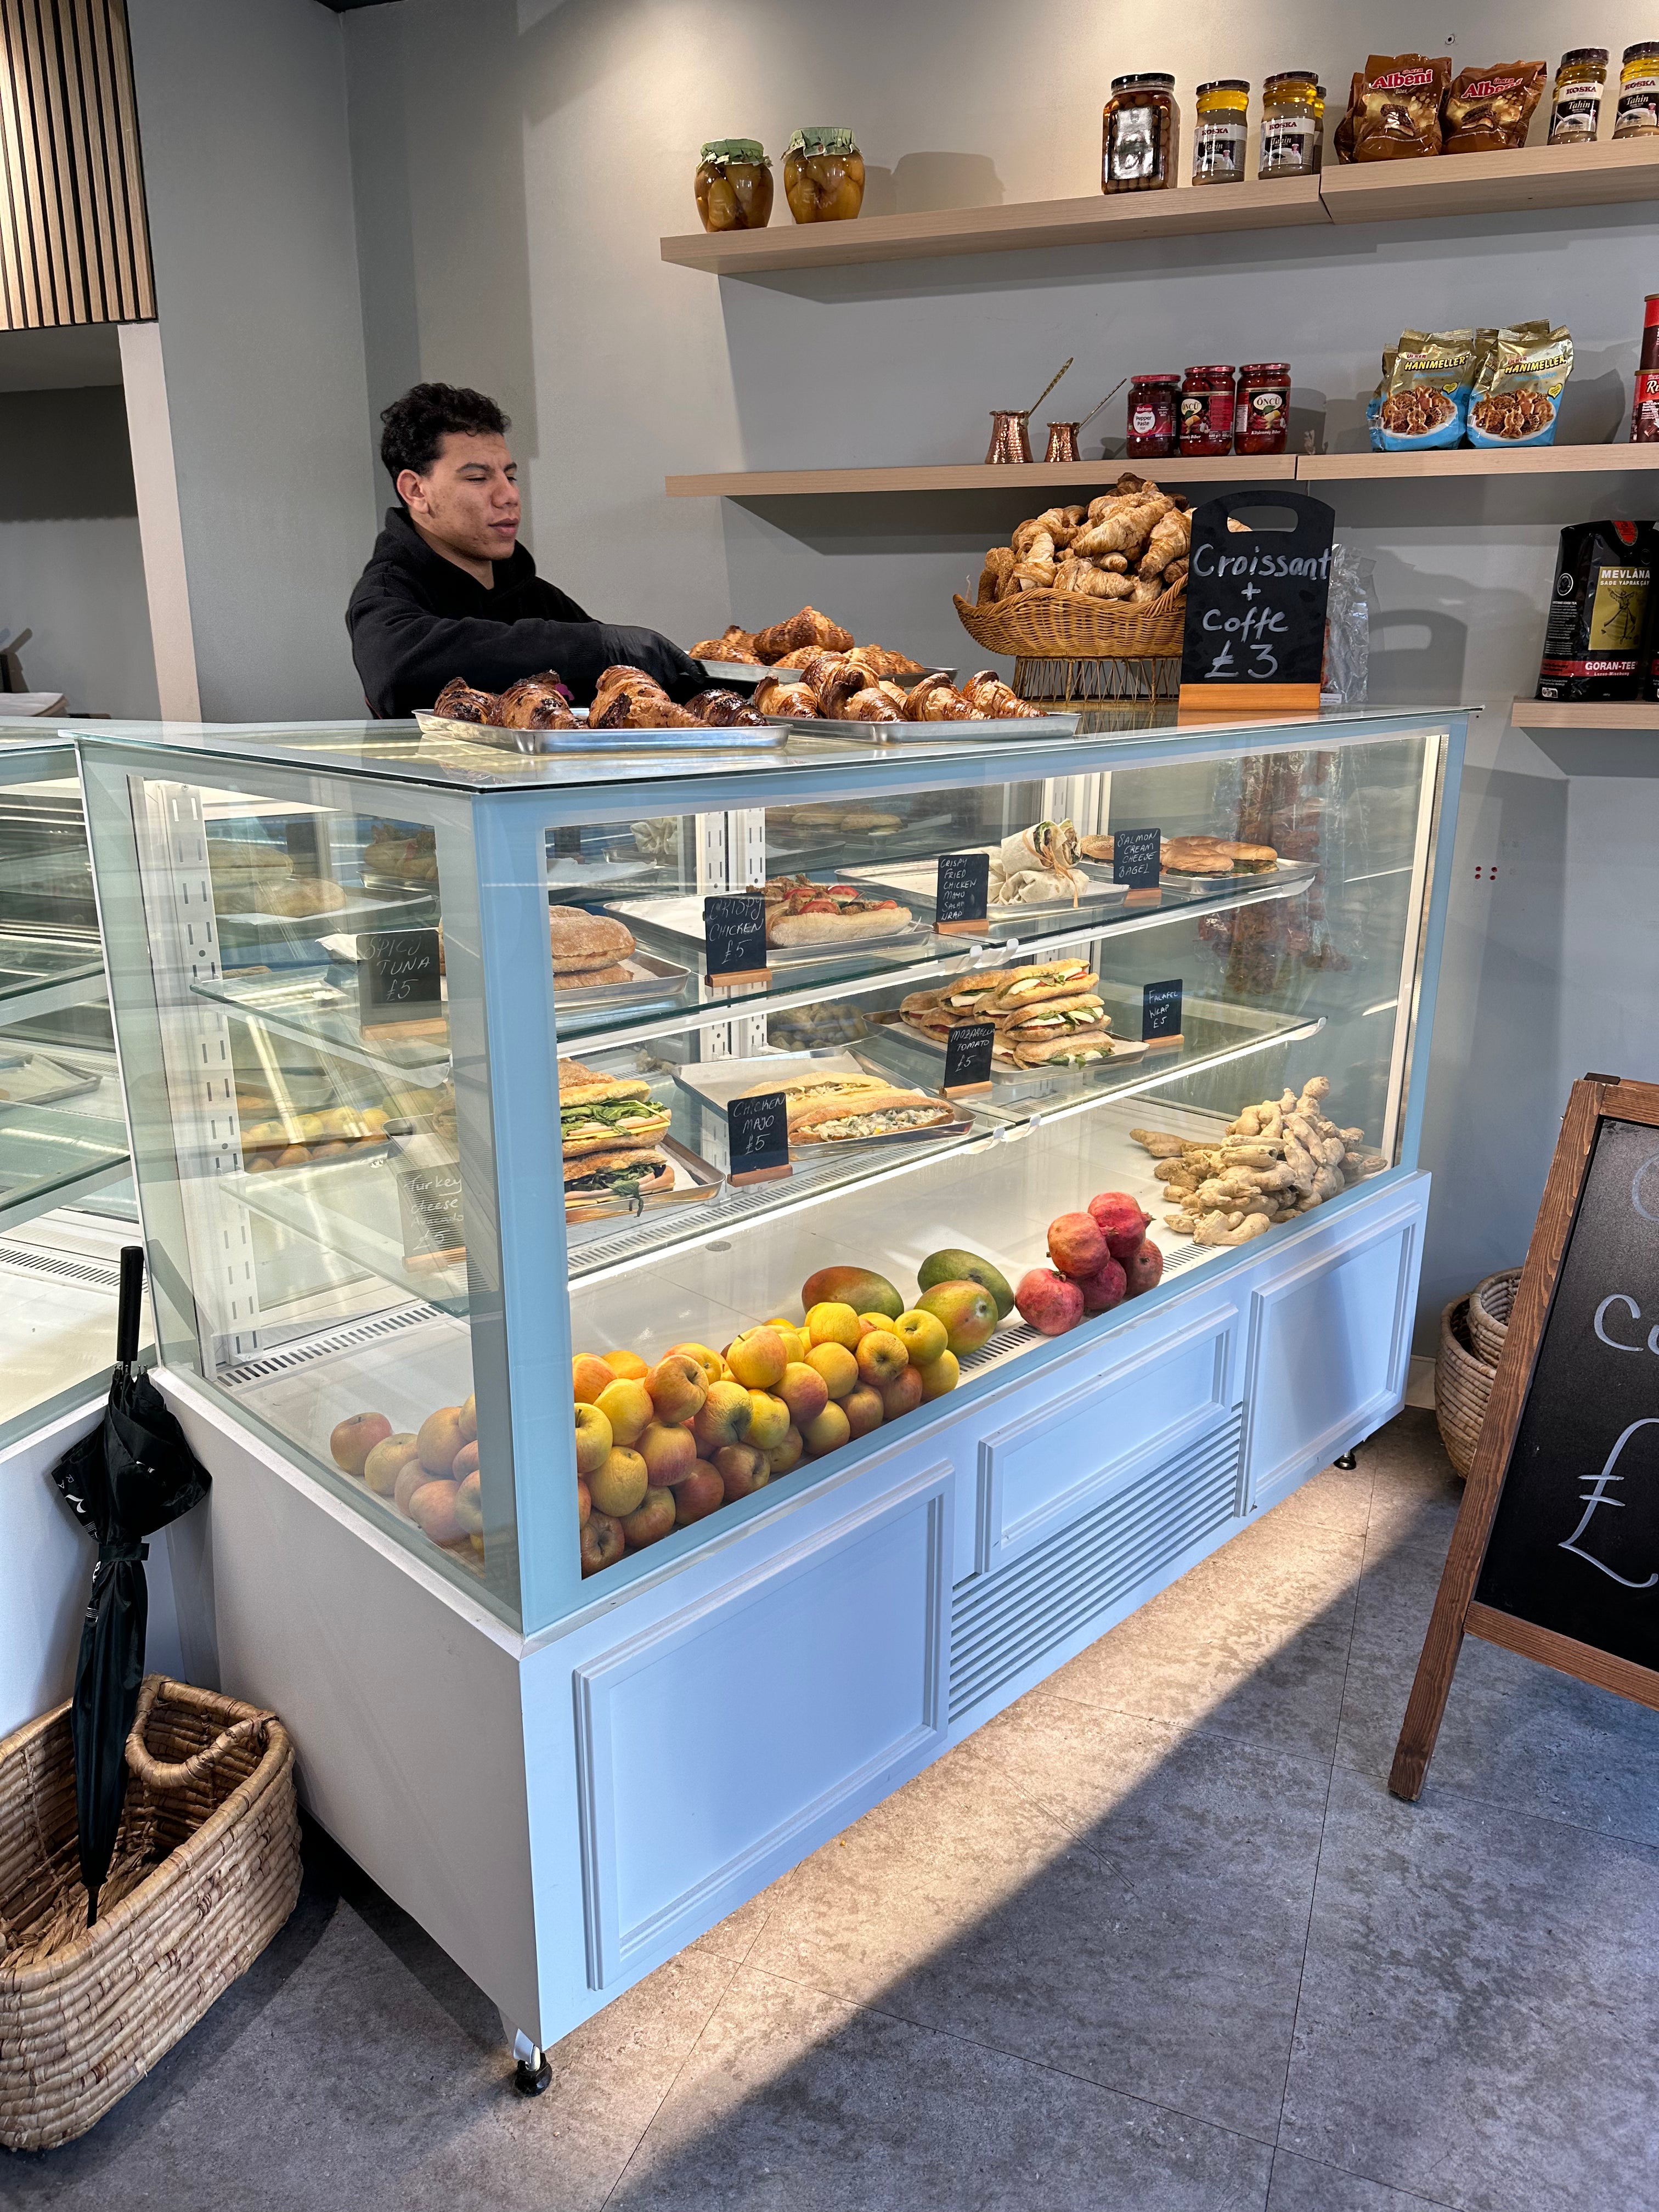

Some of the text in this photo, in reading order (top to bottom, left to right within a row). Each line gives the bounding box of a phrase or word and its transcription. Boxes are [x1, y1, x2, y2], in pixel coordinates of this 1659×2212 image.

[1371, 69, 1434, 89] Albeni
[1624, 80, 1656, 91] KOSKA
[1566, 86, 1597, 94] KOSKA
[1569, 100, 1590, 110] Tahin
[1627, 95, 1649, 105] Tahin
[1404, 356, 1467, 371] HANIMELLER
[1504, 354, 1567, 375] HANIMELLER
[1193, 543, 1332, 581] Croissant
[1118, 830, 1158, 848] SALMON
[1124, 843, 1154, 855] CREAM
[940, 858, 968, 868] CRISPY
[1122, 851, 1158, 864] CHEESE
[944, 868, 966, 879] FRIED
[1119, 863, 1150, 878] BAGEL
[943, 878, 977, 890] CHICKEN
[709, 918, 764, 942] CHICKEN
[721, 939, 753, 965] £5
[376, 956, 431, 975] TUNA
[386, 978, 420, 1002] £5
[957, 1040, 990, 1052] TOMATO
[955, 1054, 978, 1073] £5
[744, 1133, 771, 1155] £5
